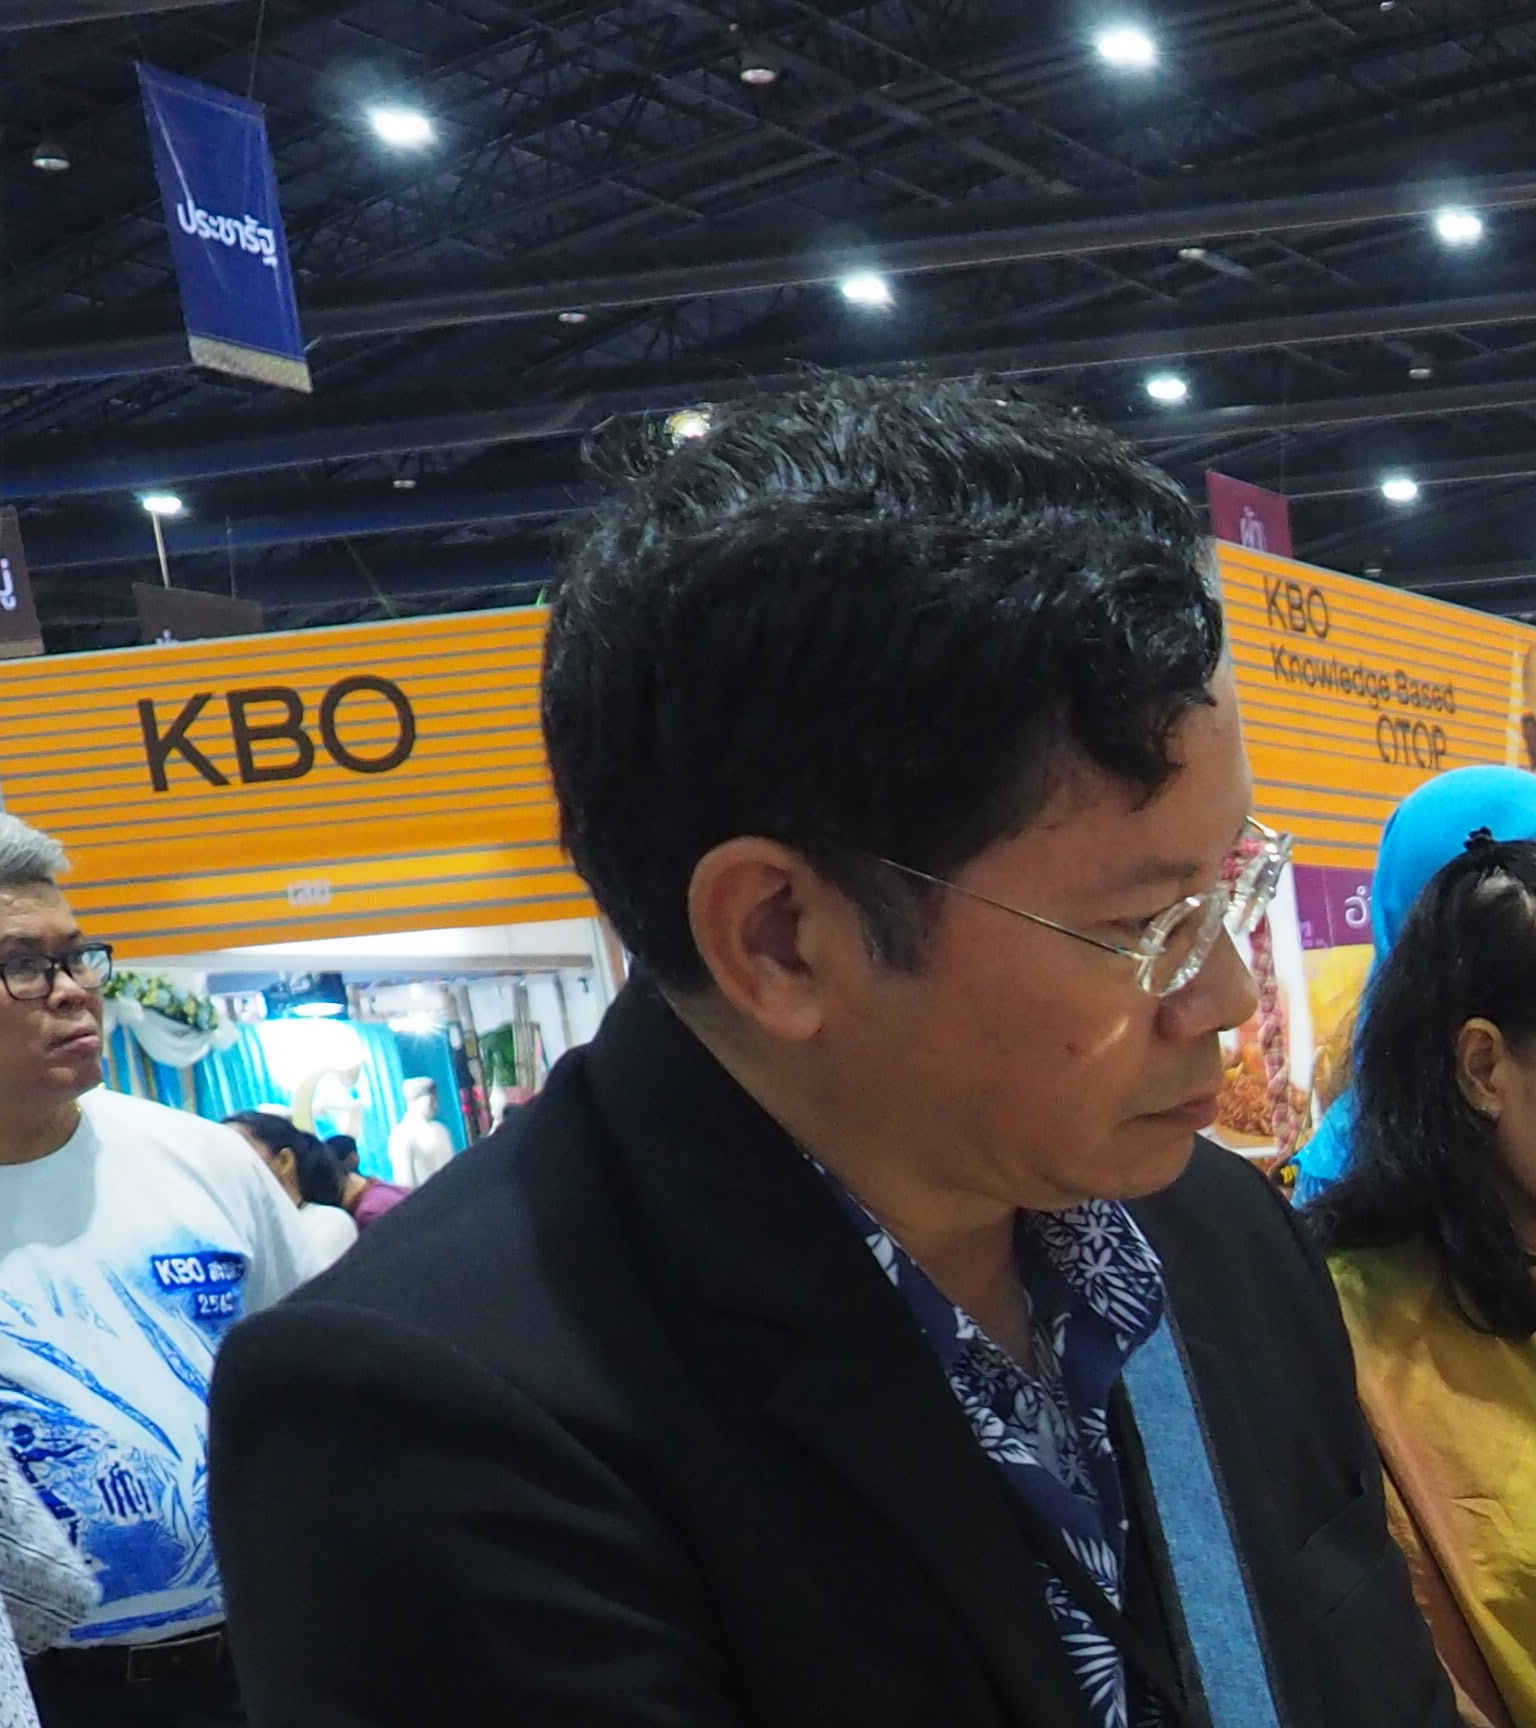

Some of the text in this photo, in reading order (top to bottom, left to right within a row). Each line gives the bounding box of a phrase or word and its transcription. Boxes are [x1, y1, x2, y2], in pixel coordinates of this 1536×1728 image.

[176, 201, 279, 267] ประชารัฐ
[1263, 574, 1330, 640] KBO
[1270, 641, 1456, 714] Knowledge Based
[138, 674, 416, 793] KBO
[1376, 714, 1447, 770] OTOP
[154, 1257, 206, 1285] KBO
